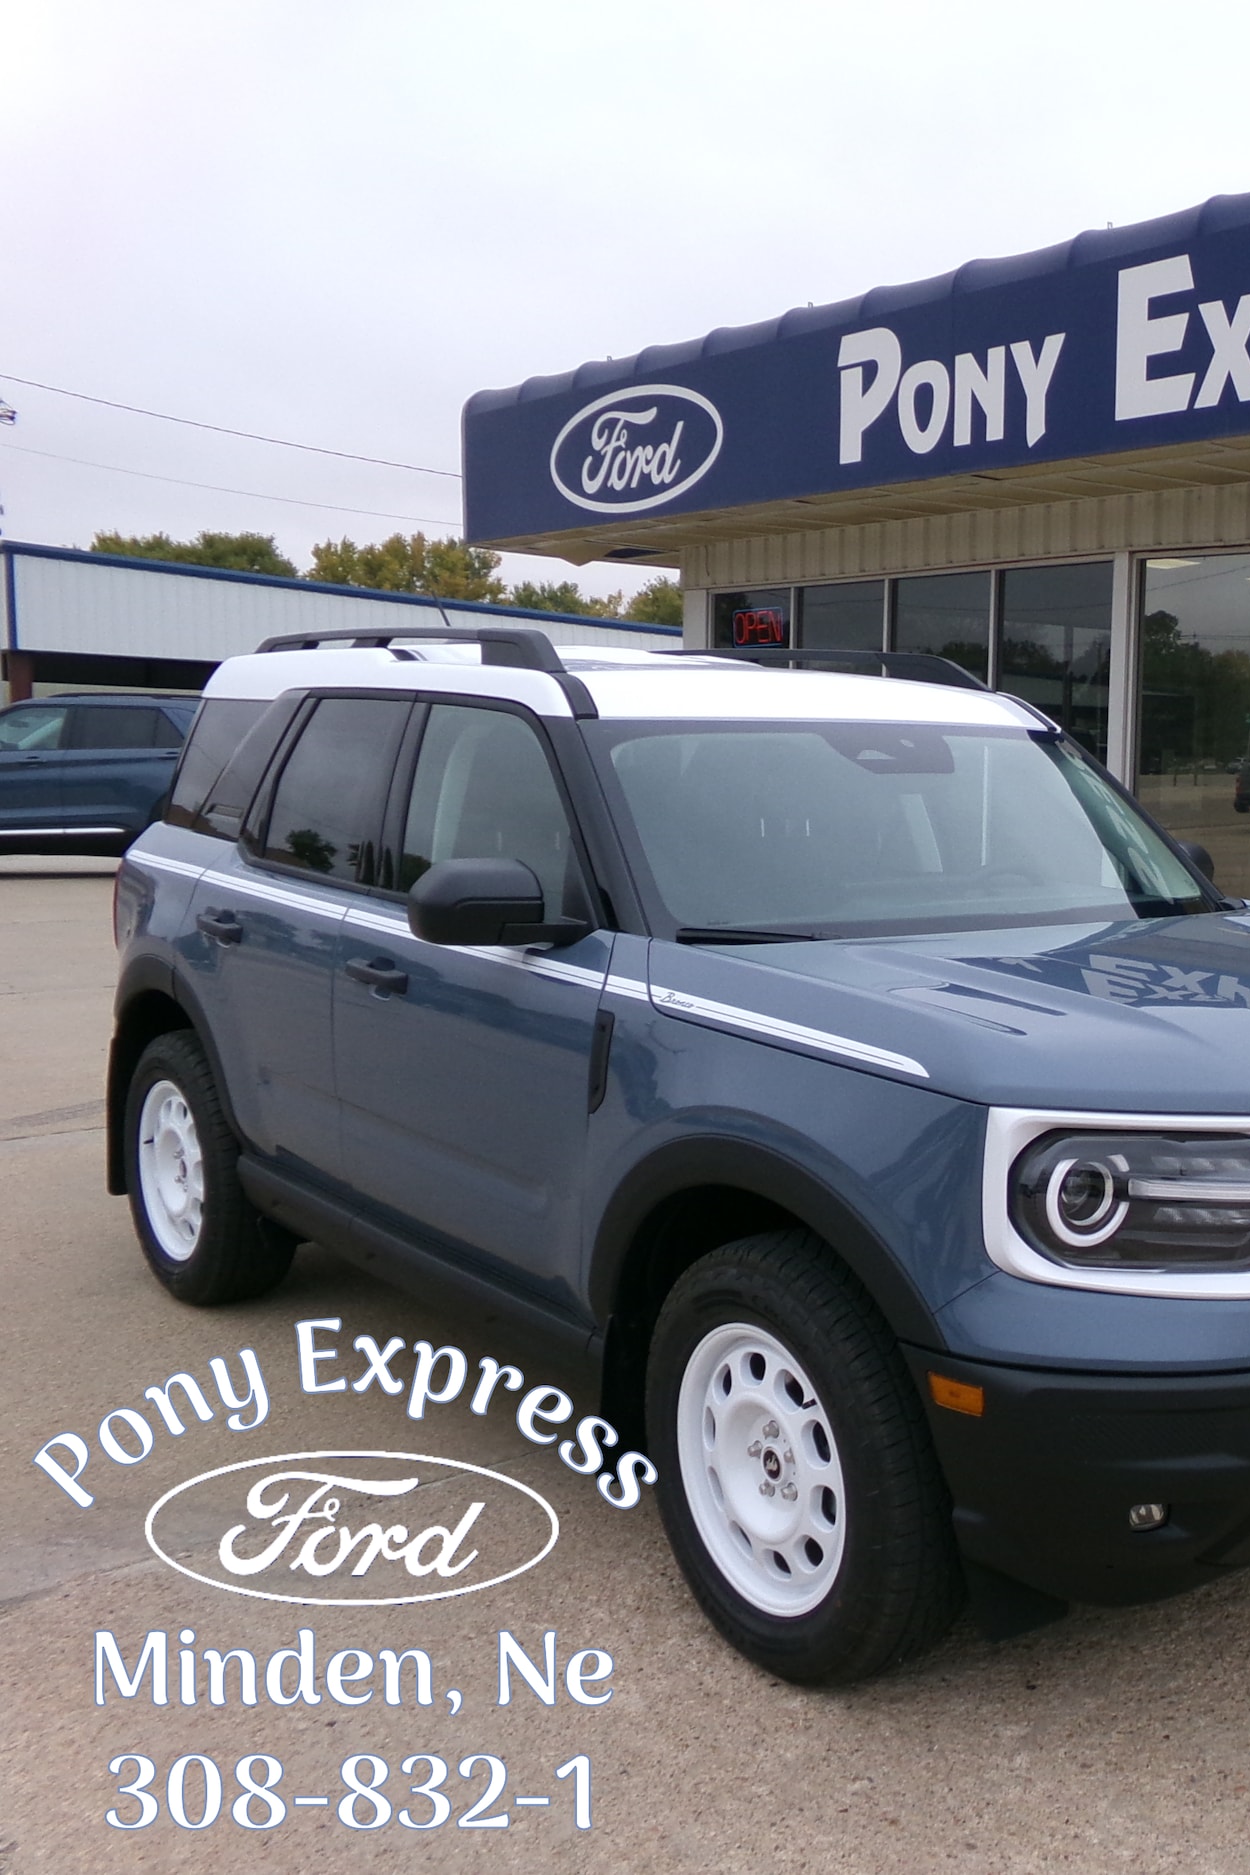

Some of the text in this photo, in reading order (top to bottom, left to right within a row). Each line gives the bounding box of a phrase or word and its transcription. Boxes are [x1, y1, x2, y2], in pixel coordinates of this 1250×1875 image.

[837, 327, 1066, 464] PONY
[581, 405, 685, 494] Ford
[734, 610, 783, 644] OPEN
